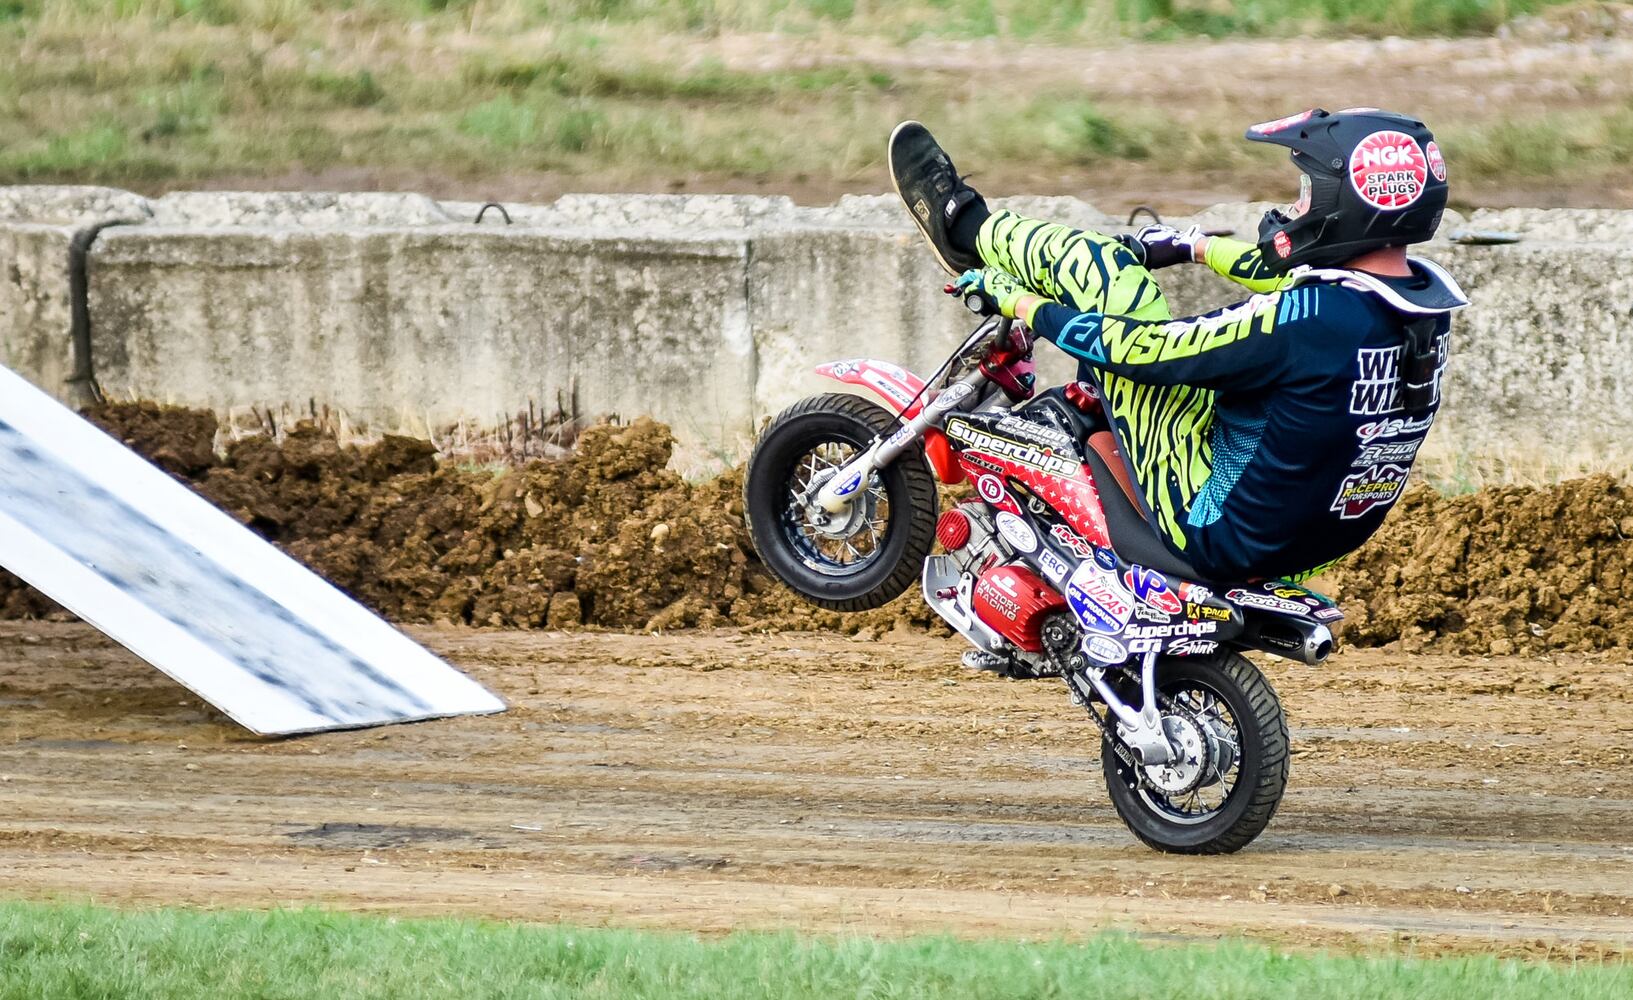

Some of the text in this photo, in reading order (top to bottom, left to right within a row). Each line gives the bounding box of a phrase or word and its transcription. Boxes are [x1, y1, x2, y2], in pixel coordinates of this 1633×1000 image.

[1362, 145, 1415, 166] NGK
[1367, 171, 1415, 183] SPARK
[1368, 183, 1416, 196] PLUGS
[950, 422, 1078, 476] Superchips
[984, 479, 998, 497] TB
[1041, 552, 1066, 575] EBC
[977, 588, 1017, 622] RACING
[980, 579, 1021, 612] FACTORY
[1079, 580, 1129, 615] LUCAS
[1069, 587, 1082, 601] OIL
[1082, 597, 1120, 630] PRODUCTS
[1123, 620, 1217, 638] Superchips
